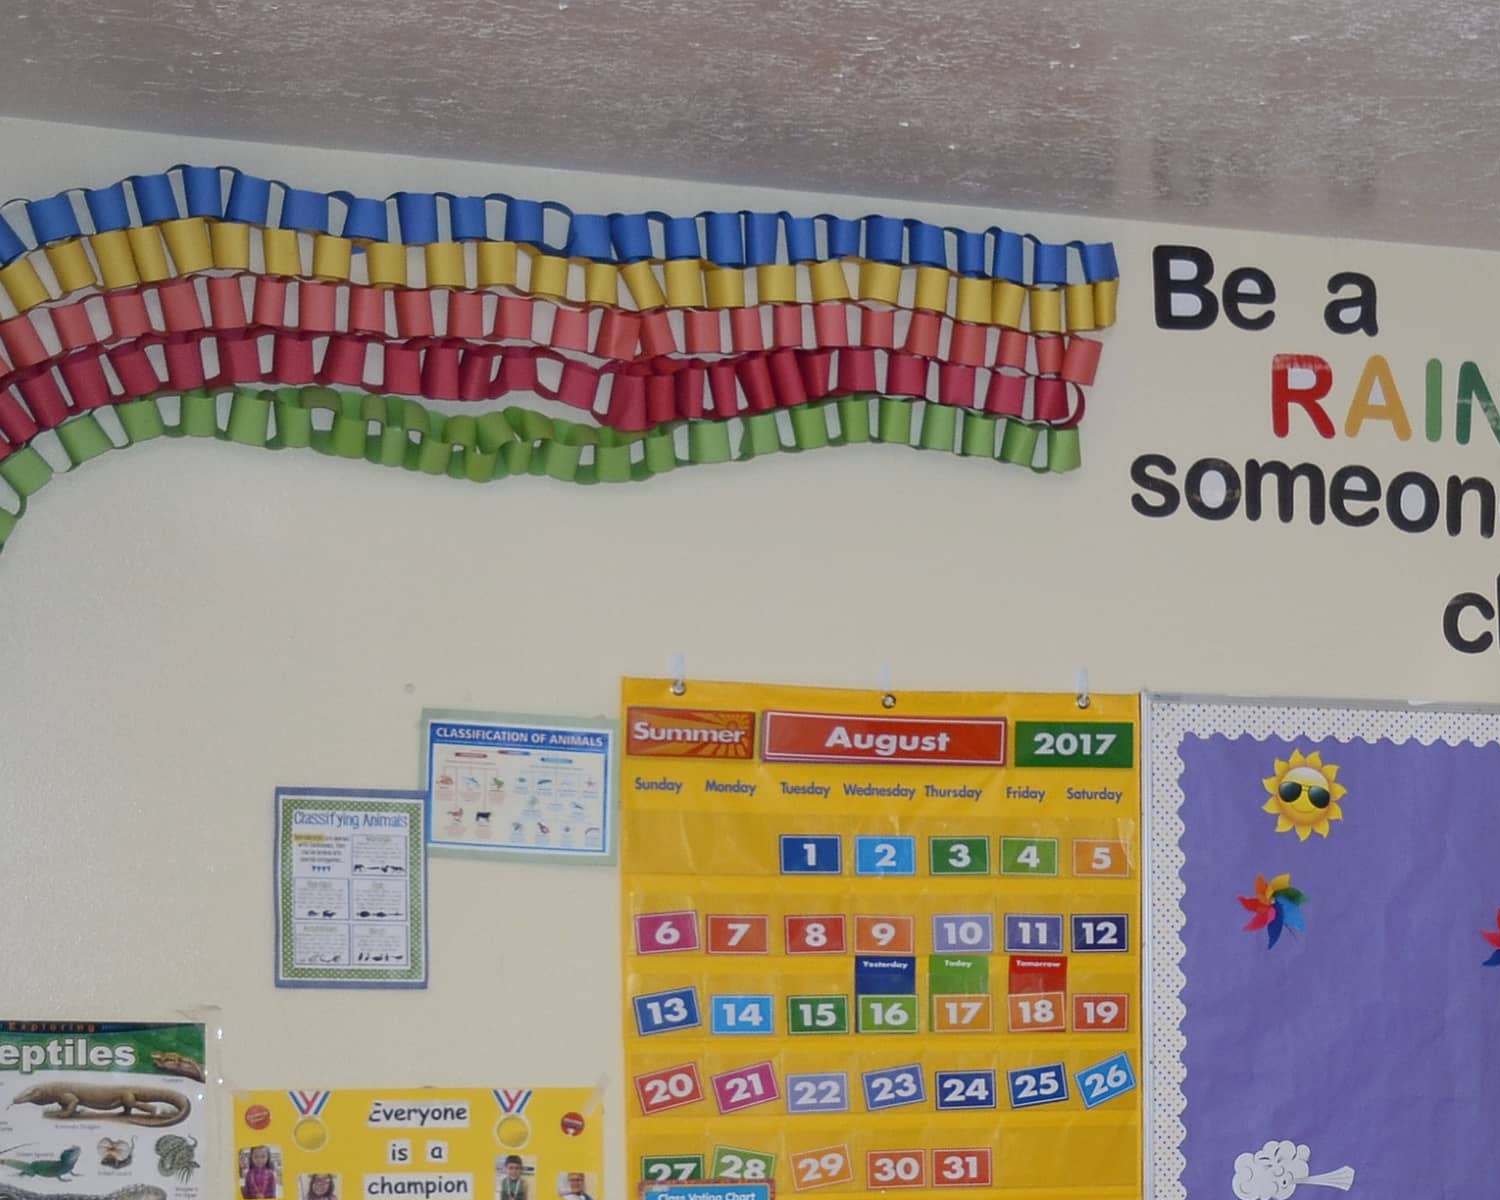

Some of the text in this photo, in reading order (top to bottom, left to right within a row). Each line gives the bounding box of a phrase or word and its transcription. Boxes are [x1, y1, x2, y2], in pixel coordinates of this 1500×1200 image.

[1152, 245, 1378, 337] Be a
[436, 727, 603, 747] CLASSIFICATION OF ANIMALS
[634, 721, 745, 744] Summer
[825, 728, 950, 755] August
[1033, 733, 1117, 756] 2017
[635, 778, 1122, 804] Sunday Monday Tuesday Wednesday Thursday Friday Saturday
[294, 811, 408, 830] Classifying Animals
[802, 843, 1111, 870] 1 2 3 4 5
[655, 921, 1117, 946] 6 7 8 9 10 11 12
[862, 961, 909, 969] Yesterday
[944, 960, 973, 968] Today
[1016, 960, 1061, 968] Tomorrow
[647, 998, 1119, 1026] 13 14 15 16 17 18 19
[0, 1038, 136, 1073] eptiles
[645, 1066, 1126, 1104] 20 21 22 23 24 25 26
[368, 1102, 468, 1126] Everyone
[390, 1141, 443, 1162] is a
[649, 1153, 977, 1181] 27 28 29 30 31
[367, 1175, 468, 1200] champion
